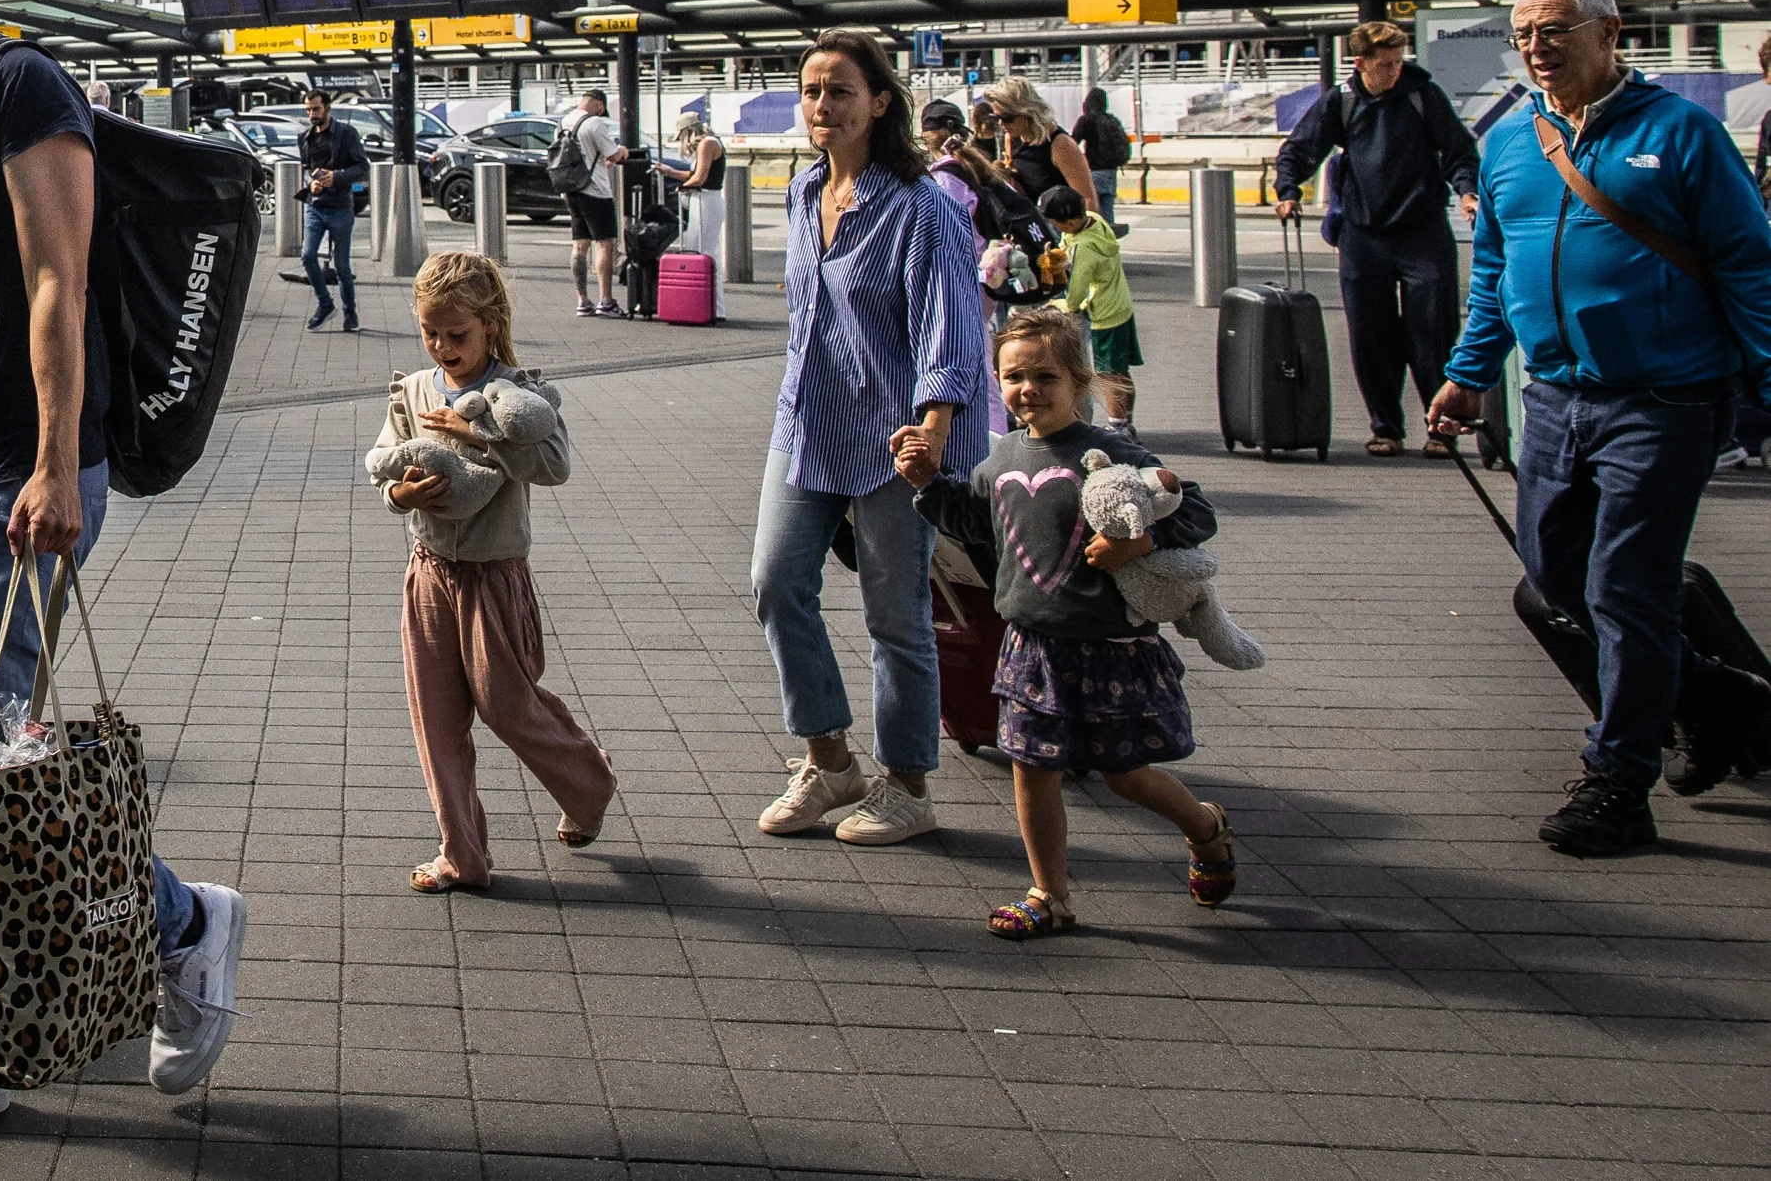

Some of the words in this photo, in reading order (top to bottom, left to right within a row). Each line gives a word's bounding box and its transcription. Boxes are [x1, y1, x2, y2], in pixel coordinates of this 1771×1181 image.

[607, 18, 630, 31] Taxi
[322, 32, 332, 40] Bus
[352, 33, 359, 45] B
[379, 31, 388, 44] D
[456, 30, 474, 38] Hotel
[475, 29, 502, 37] shuttles
[1437, 27, 1505, 40] Bushaltes
[246, 42, 257, 50] App
[258, 40, 278, 49] pick-up
[279, 39, 294, 48] point
[175, 232, 219, 351] HANSEN
